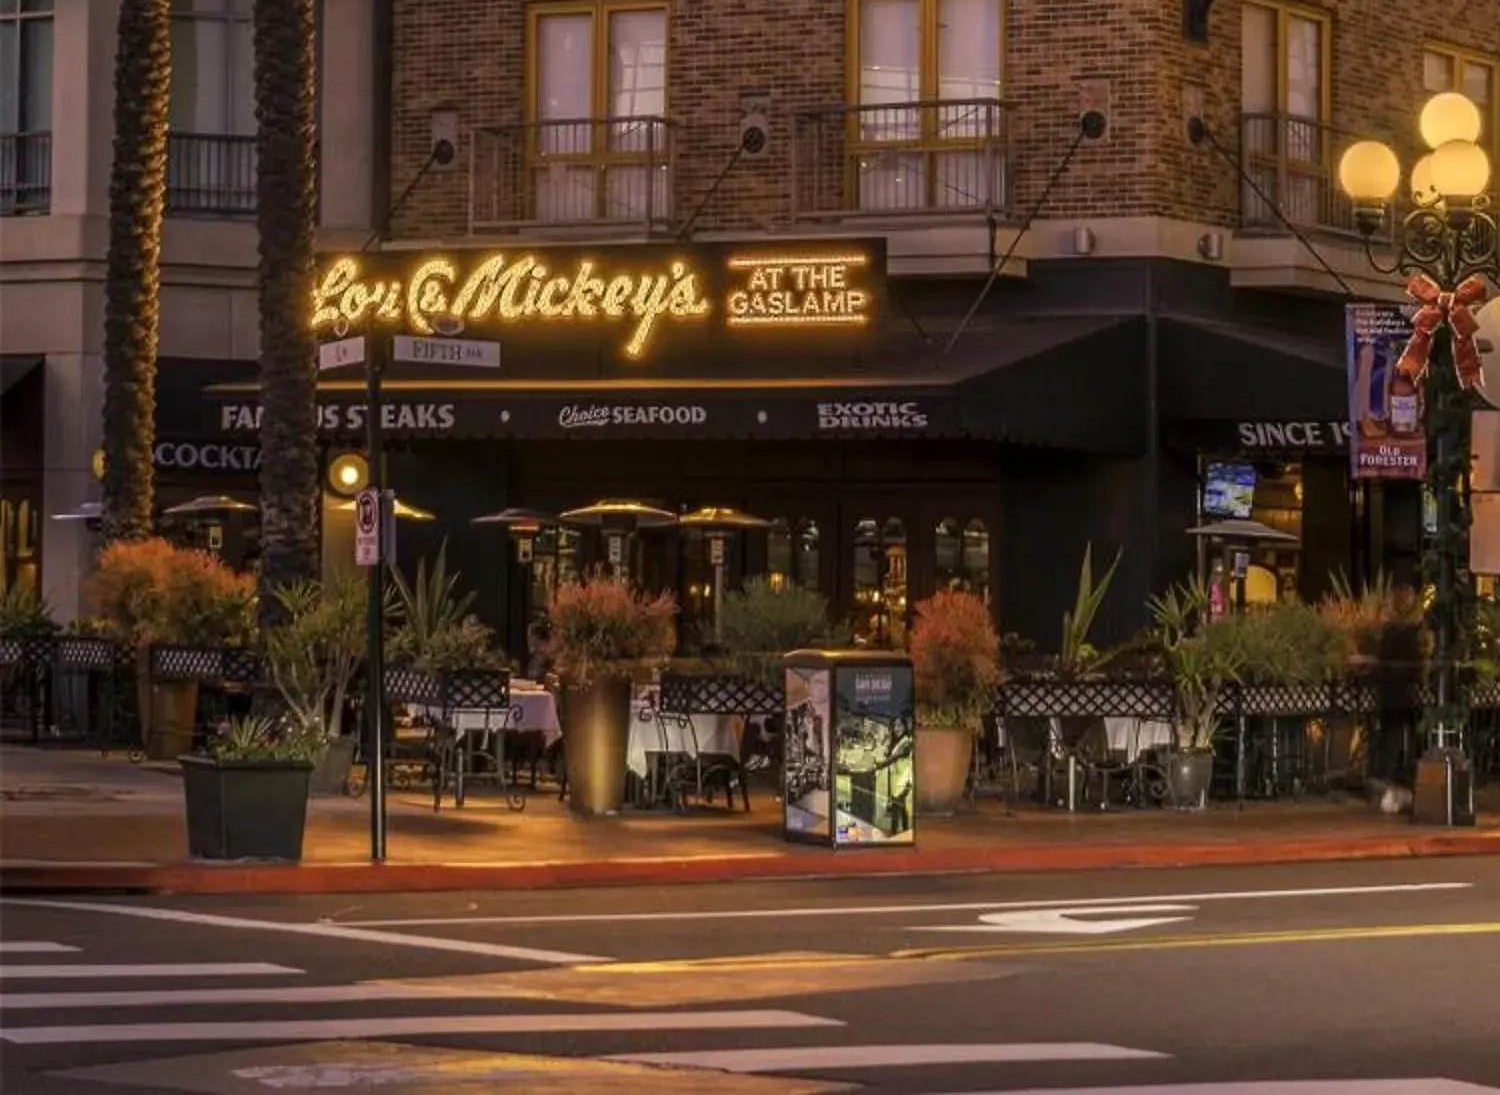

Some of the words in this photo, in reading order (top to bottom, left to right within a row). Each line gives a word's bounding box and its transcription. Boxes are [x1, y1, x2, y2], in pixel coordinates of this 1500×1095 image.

[750, 267, 783, 290] AT
[791, 265, 847, 289] THE
[310, 257, 401, 326] Lou
[449, 253, 708, 356] Mickey's
[729, 290, 866, 316] GASLAMP
[412, 340, 462, 361] FIFTH
[559, 405, 610, 427] Choice
[612, 406, 707, 425] SEAFOOD
[817, 402, 920, 415] EXOTIC
[818, 414, 929, 428] DRINKS
[1238, 422, 1324, 446] SINCE
[1360, 454, 1418, 466] FORESTER
[1379, 445, 1401, 456] OLD
